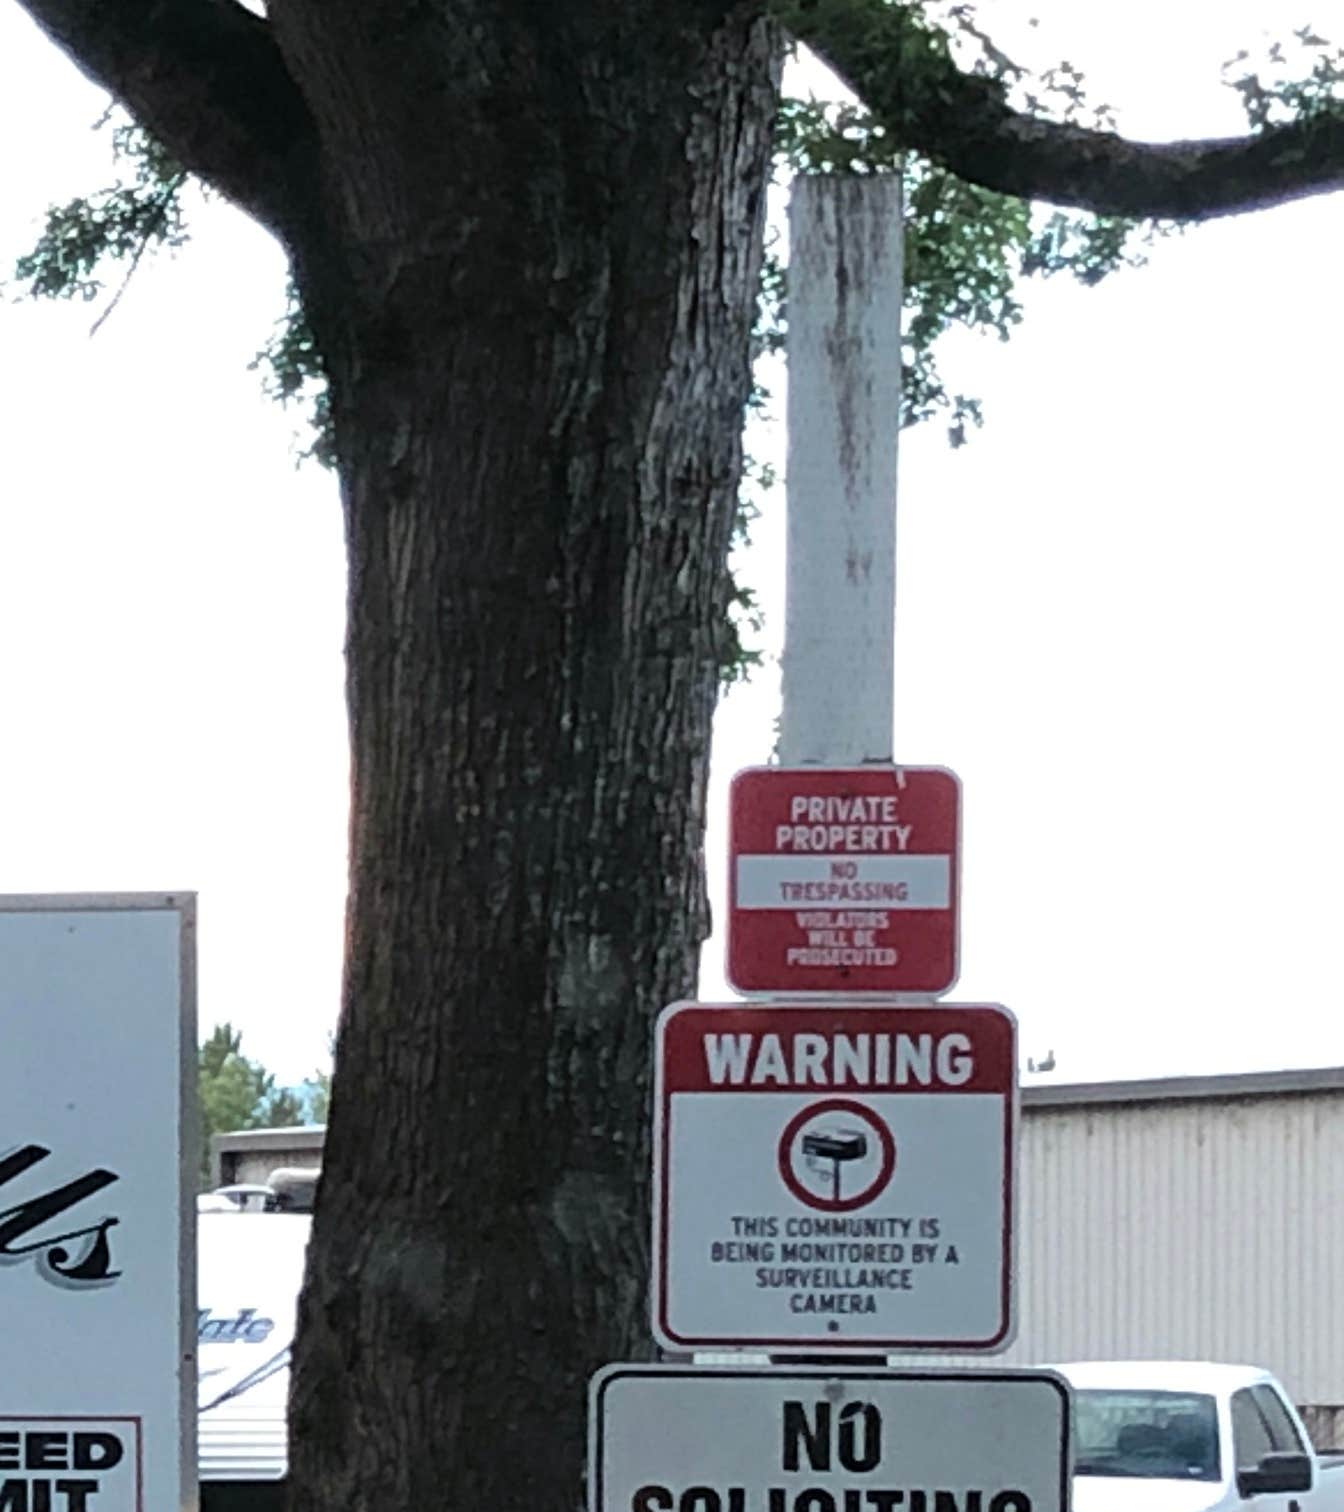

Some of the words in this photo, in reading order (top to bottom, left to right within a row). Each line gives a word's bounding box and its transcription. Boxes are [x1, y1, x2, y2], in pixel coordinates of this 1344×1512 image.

[791, 796, 898, 823] PRIVATE
[776, 825, 912, 851] PROPERTY
[830, 861, 858, 880] NO
[780, 881, 909, 901] TRESPASSING
[796, 911, 889, 929] VIOLATORS
[807, 930, 848, 947] WILL
[853, 930, 876, 948] BE
[787, 948, 898, 966] PROSECUTED
[705, 1033, 973, 1086] WARNING
[731, 1216, 778, 1237] THIS
[785, 1217, 912, 1238] COMMUNITY
[919, 1217, 940, 1238] IS
[711, 1241, 774, 1263] BEING
[781, 1243, 904, 1264] MONITORED
[911, 1244, 938, 1264] BY
[944, 1245, 960, 1264] A
[756, 1268, 913, 1290] SURVEILLANCE
[788, 1293, 877, 1314] CAMERA
[782, 1401, 883, 1472] NO
